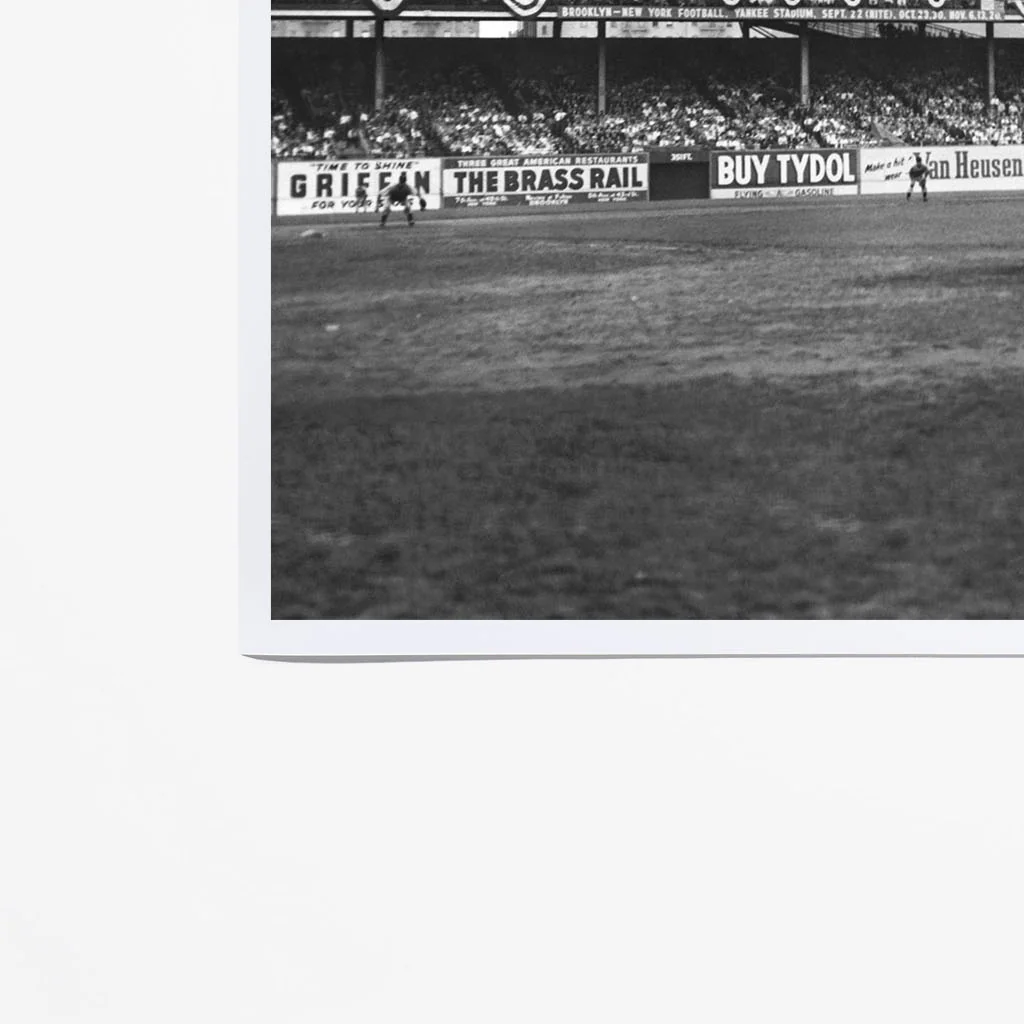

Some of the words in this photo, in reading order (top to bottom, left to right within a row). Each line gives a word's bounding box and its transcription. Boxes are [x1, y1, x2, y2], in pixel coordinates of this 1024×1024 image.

[648, 7, 672, 18] YORK
[734, 7, 769, 18] YANKEE
[354, 162, 370, 170] TO
[457, 159, 487, 168] THREE
[490, 158, 519, 167] GREAT
[523, 157, 571, 167] AMERICAN
[575, 155, 639, 165] RESTAURANTS
[955, 150, 1023, 179] Heusen
[717, 154, 770, 186] BUY
[776, 152, 856, 184] TYDOL
[290, 170, 430, 198] GRIFFN
[454, 171, 499, 194] THE
[504, 168, 585, 192] BRASS
[590, 166, 643, 189] RAIL
[795, 188, 833, 197] GASOLINE
[311, 200, 335, 209] FOR
